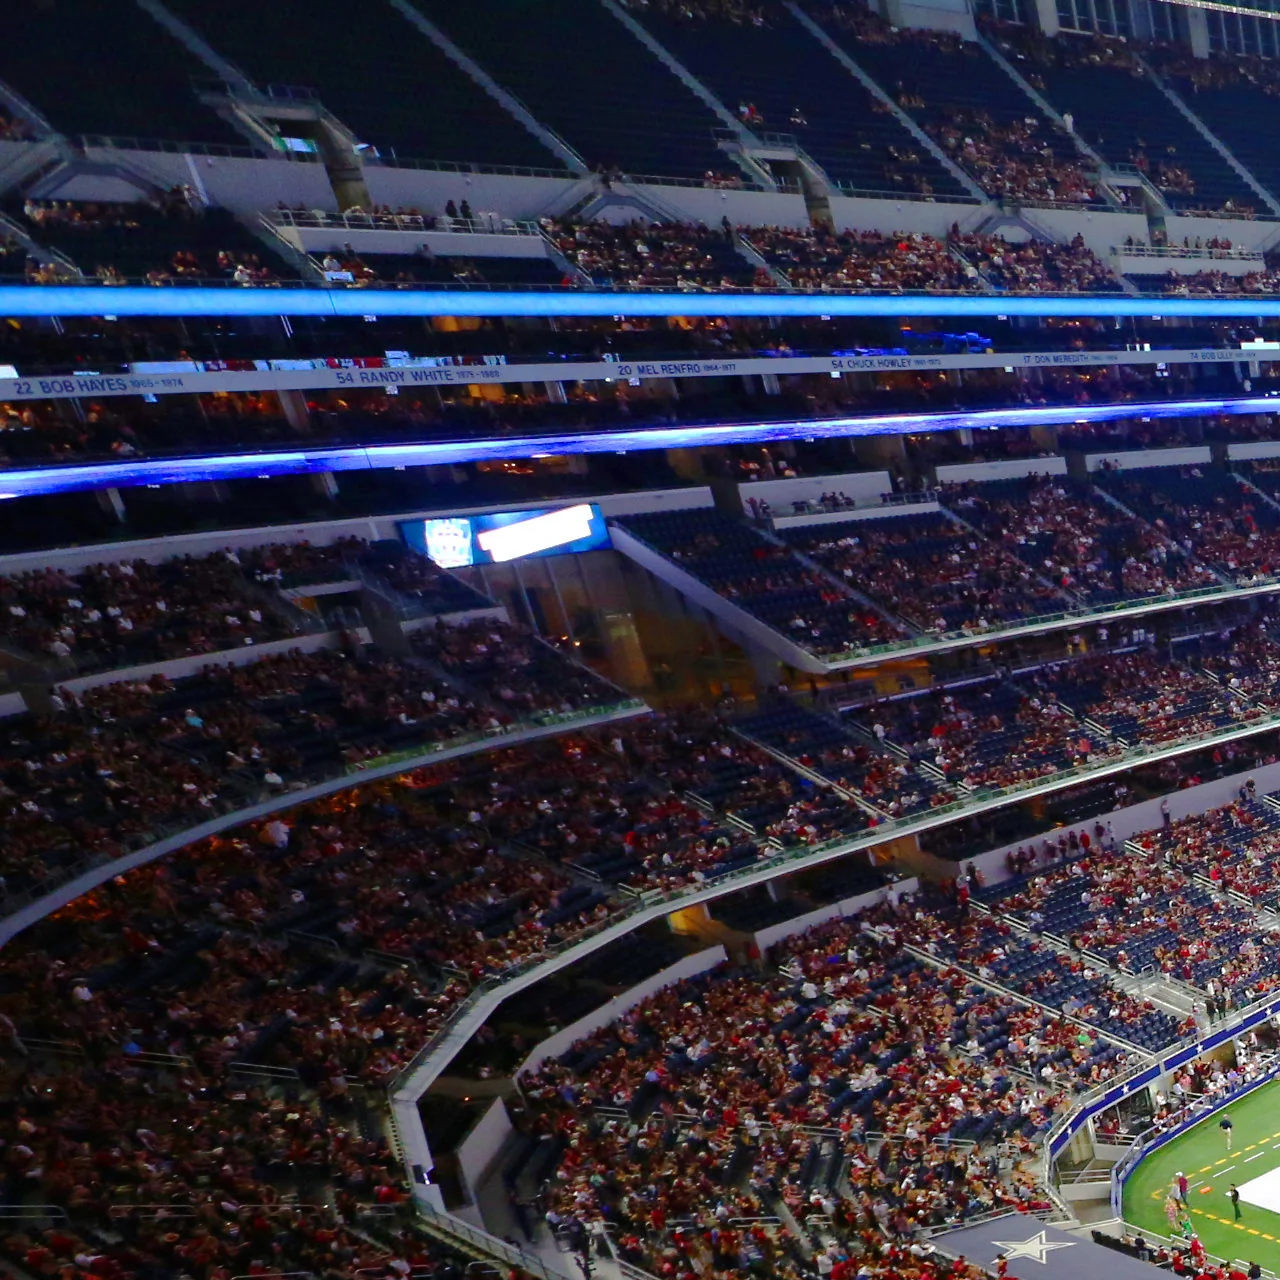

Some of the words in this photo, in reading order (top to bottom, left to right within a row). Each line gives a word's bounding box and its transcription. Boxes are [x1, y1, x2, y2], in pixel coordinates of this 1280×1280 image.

[1035, 355, 1051, 363] DON
[1053, 354, 1089, 363] MEREDITH
[1201, 352, 1216, 360] BOB
[1217, 351, 1233, 359] LILLY
[618, 365, 632, 376] 20
[637, 364, 659, 375] MEL
[661, 363, 701, 374] RENFRO
[831, 360, 844, 369] 54
[847, 359, 876, 369] CHUCK
[877, 358, 912, 368] HOWLEY
[336, 372, 354, 385] 54
[360, 371, 405, 384] RANDY
[411, 369, 454, 382] WHITE
[14, 381, 34, 395] 22
[39, 379, 75, 394] BOB
[77, 376, 128, 392] HAYES
